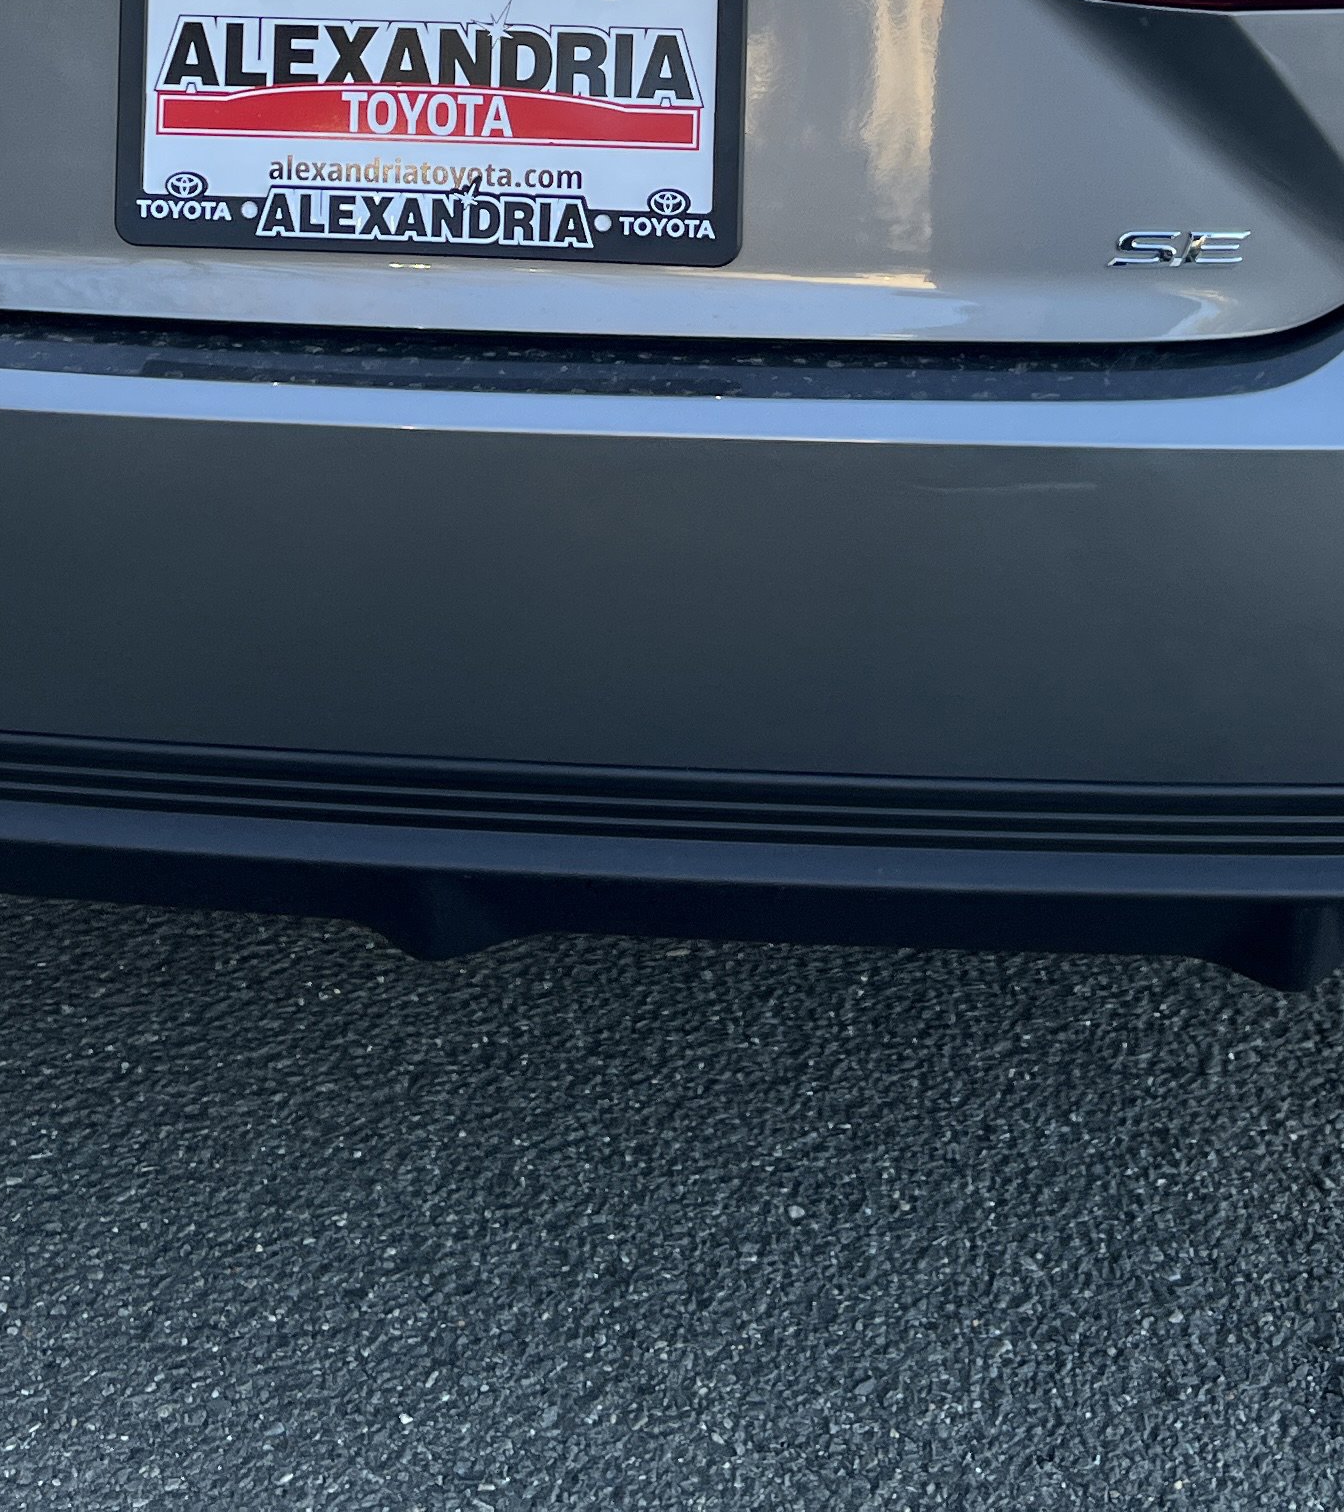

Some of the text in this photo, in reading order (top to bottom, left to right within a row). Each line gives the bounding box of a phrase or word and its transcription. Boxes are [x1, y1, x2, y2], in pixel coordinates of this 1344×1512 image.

[160, 18, 698, 102] ALEXANDRIA
[341, 90, 514, 138] TOYOTA
[267, 154, 583, 192] alexandriatoyota.com
[136, 199, 233, 221] TOYOTA
[259, 189, 592, 247] ALEXANDRIA
[618, 215, 717, 240] TOYOTA
[1106, 230, 1253, 268] SE
